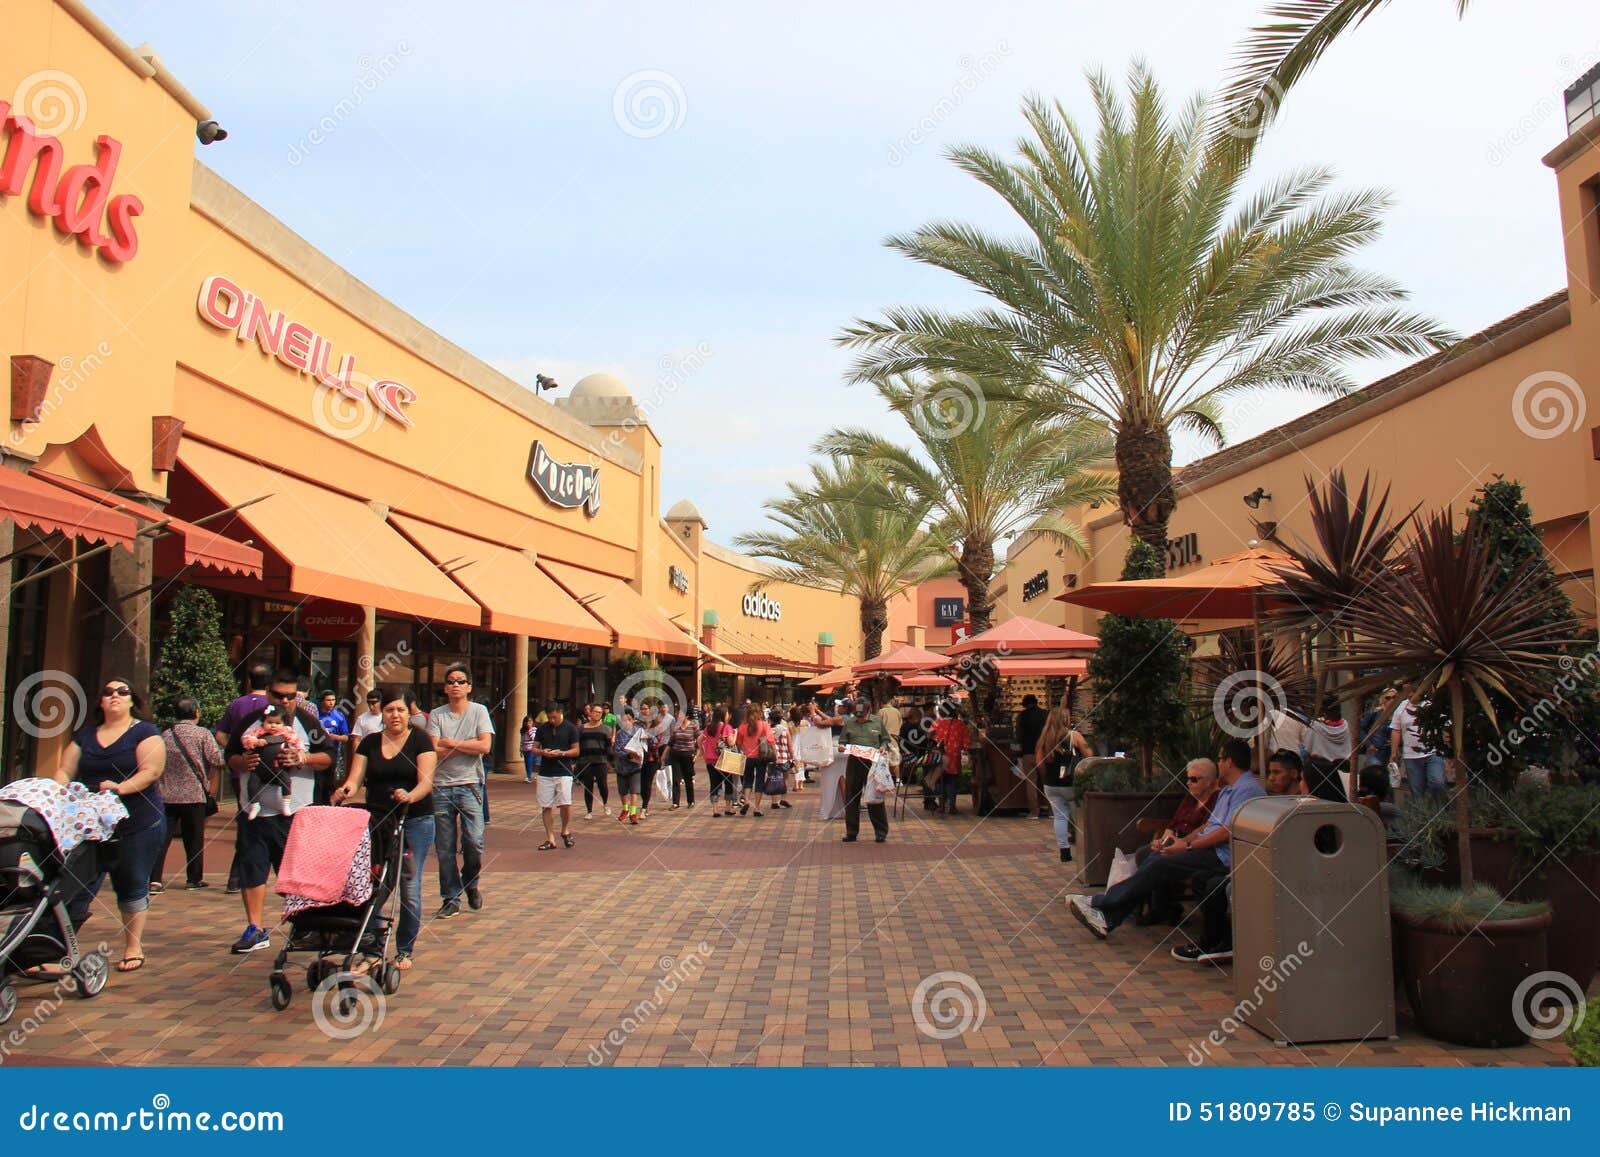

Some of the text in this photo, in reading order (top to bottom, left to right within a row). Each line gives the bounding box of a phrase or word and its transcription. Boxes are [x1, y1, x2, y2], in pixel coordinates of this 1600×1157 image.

[197, 276, 366, 402] O'NEILL
[1165, 532, 1202, 570] SSIL
[742, 591, 781, 621] adidas
[941, 604, 959, 617] GAP
